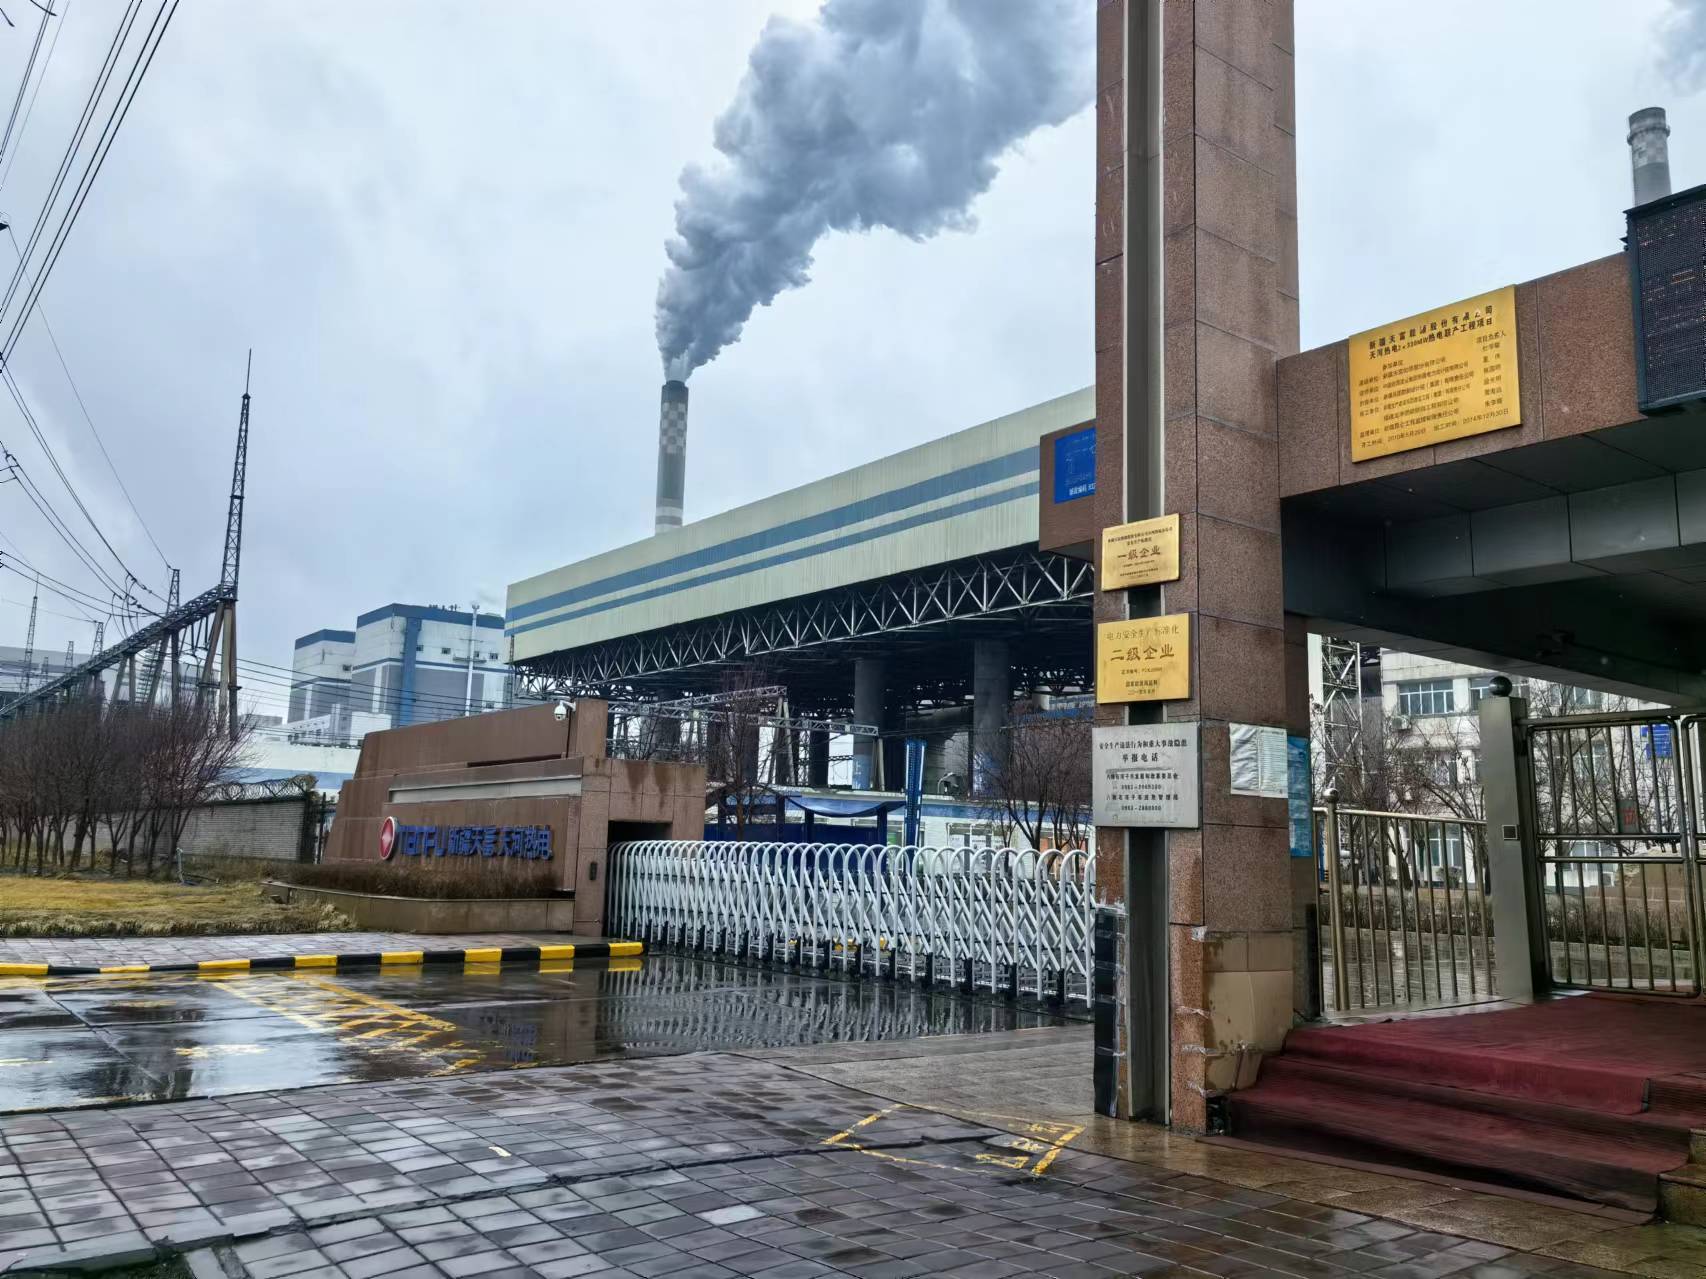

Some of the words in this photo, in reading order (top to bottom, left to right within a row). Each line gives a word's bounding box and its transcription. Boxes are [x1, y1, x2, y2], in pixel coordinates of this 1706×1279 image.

[1117, 544, 1161, 560] 一级企业
[1110, 643, 1175, 661] 二级企业
[1122, 752, 1160, 764] 举报电话
